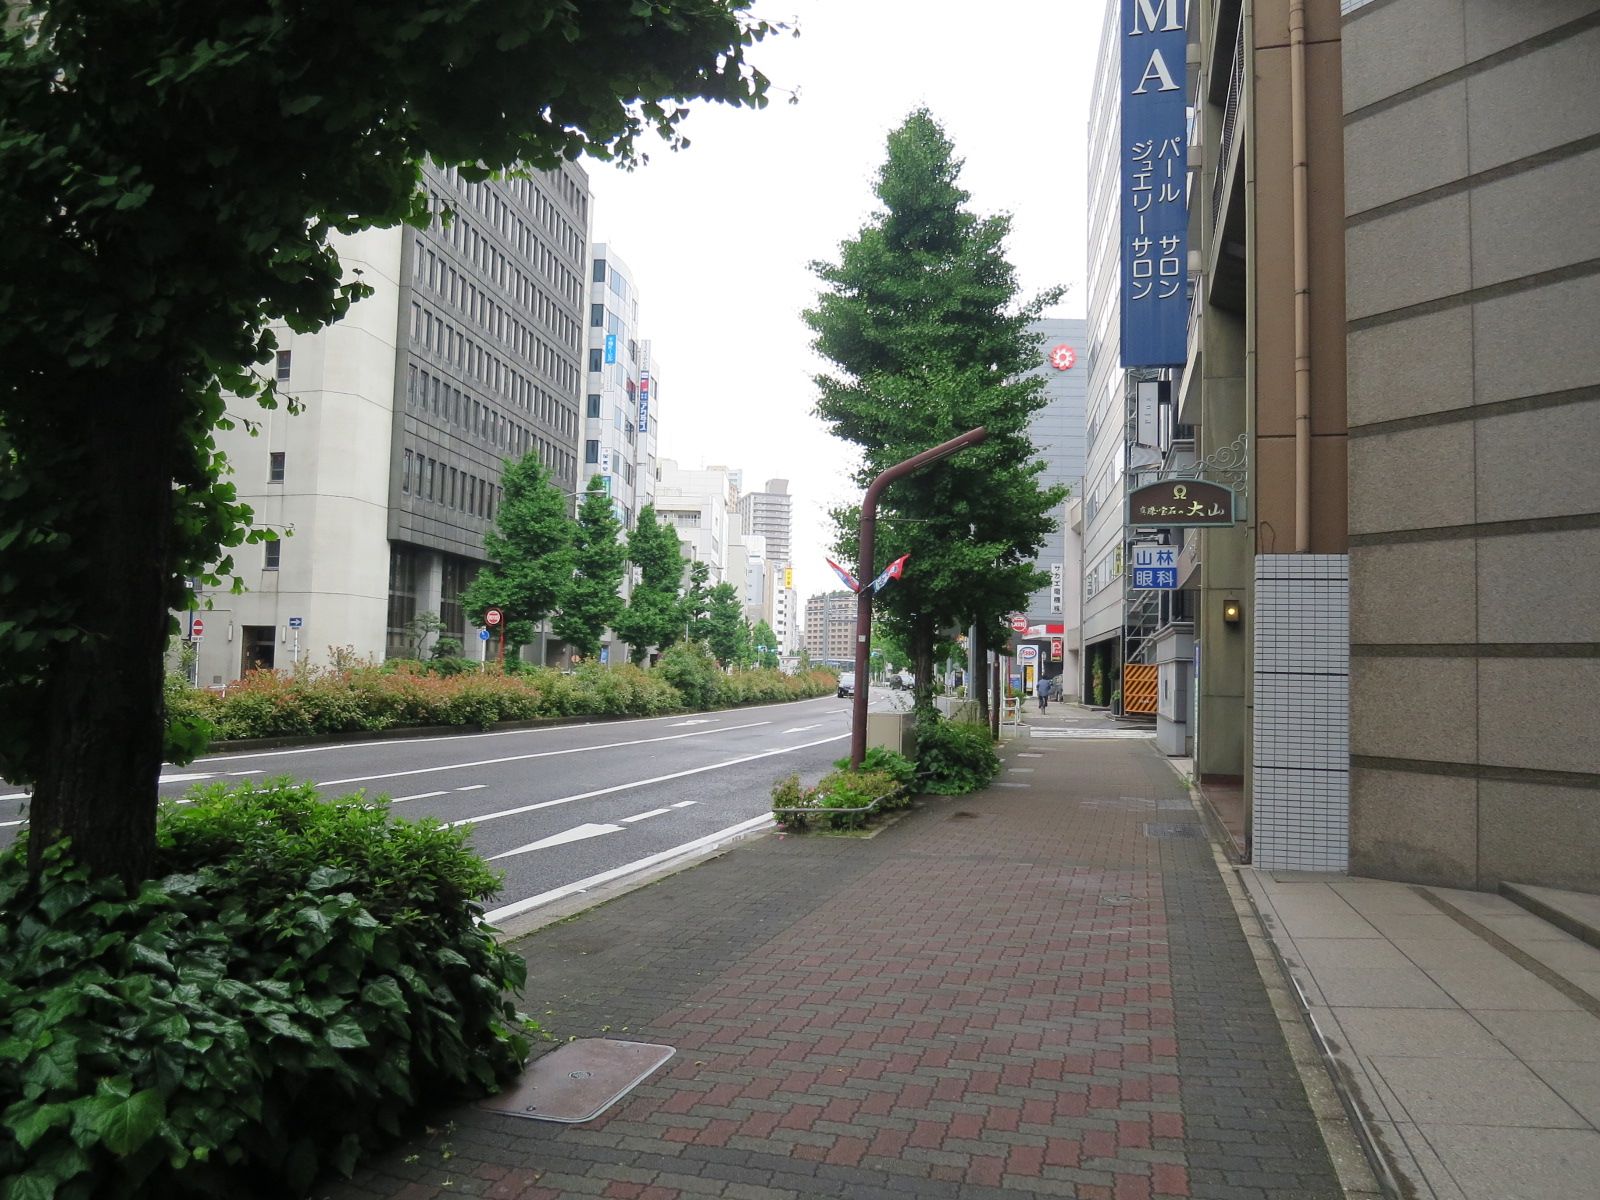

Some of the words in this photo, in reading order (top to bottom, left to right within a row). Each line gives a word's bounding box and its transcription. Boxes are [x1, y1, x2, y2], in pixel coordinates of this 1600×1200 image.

[1158, 137, 1181, 202] パール
[1131, 140, 1152, 299] ジュエリーサロン
[1159, 235, 1180, 299] サロン
[1136, 550, 1173, 565] 山林
[1136, 570, 1173, 587] 眼科
